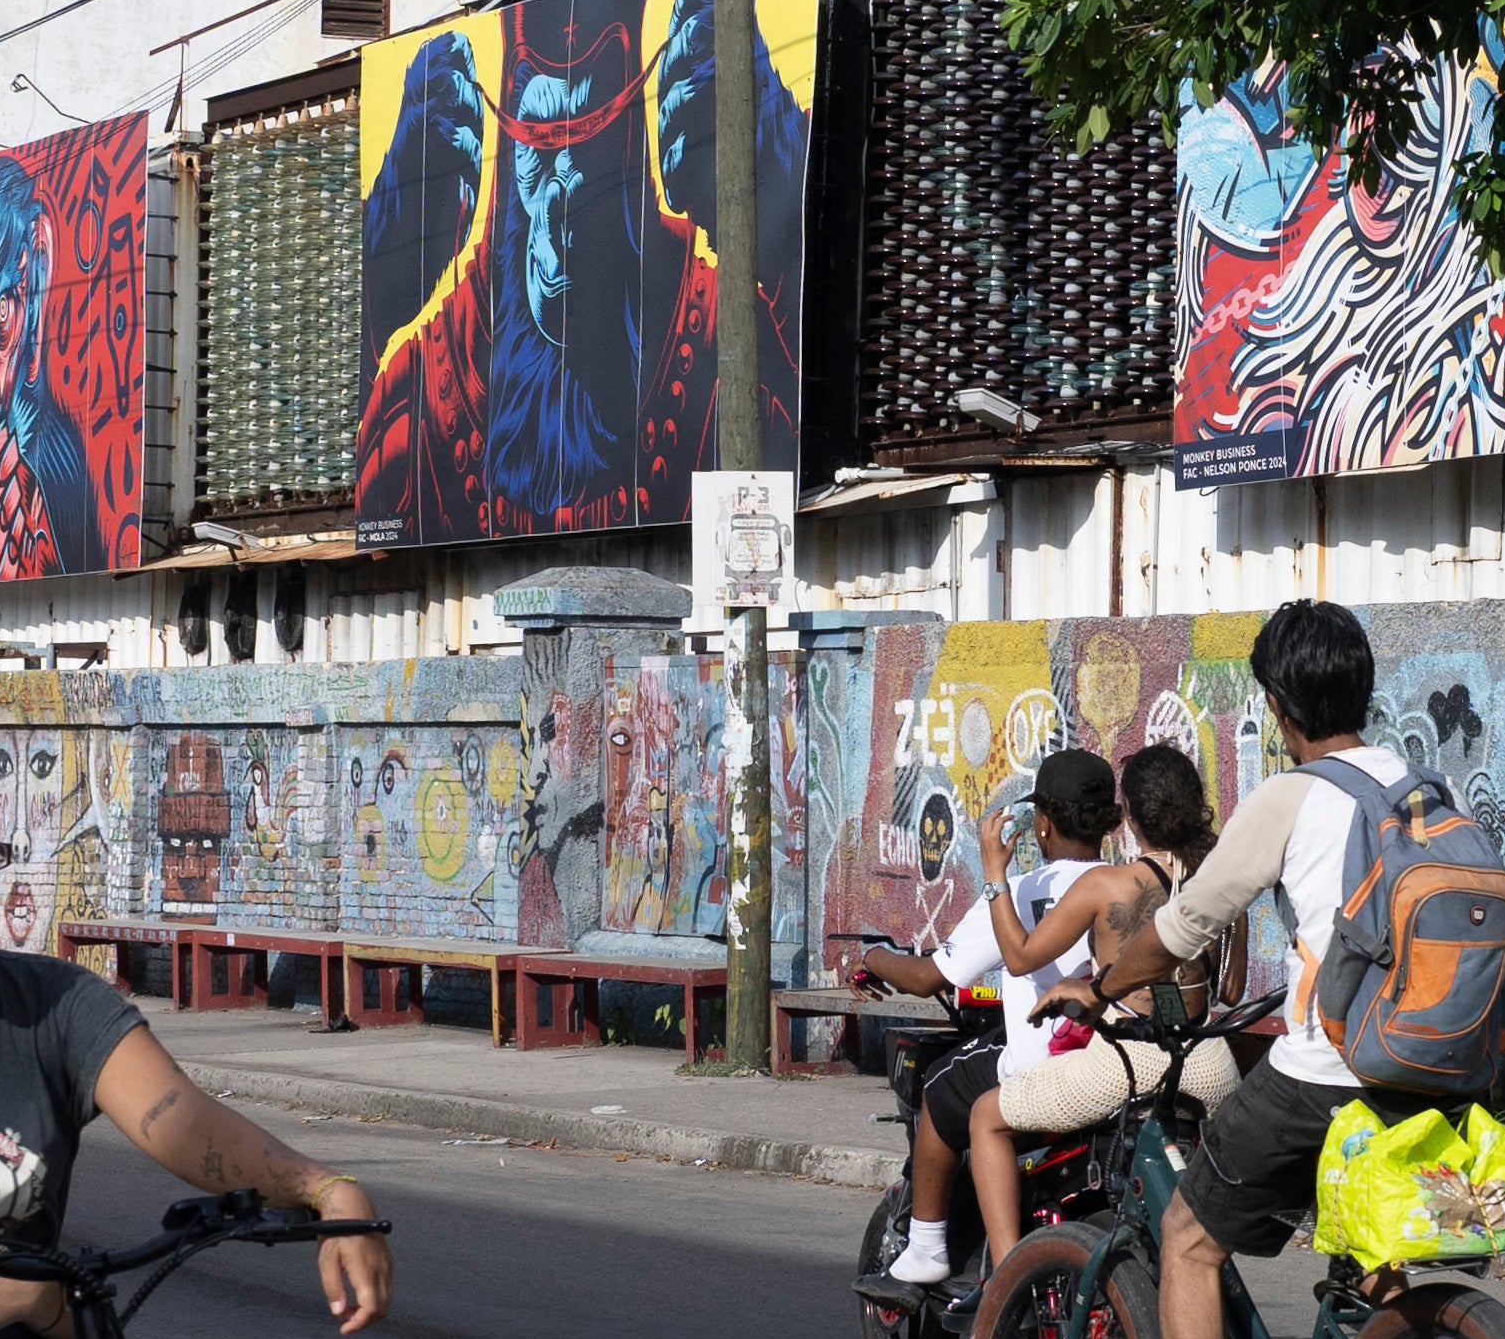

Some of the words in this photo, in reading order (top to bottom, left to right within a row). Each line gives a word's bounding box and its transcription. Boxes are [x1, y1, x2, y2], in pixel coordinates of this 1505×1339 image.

[1182, 450, 1214, 465] MONKEY
[1216, 445, 1256, 460] BUSINESS
[1183, 468, 1198, 480] FAC
[1203, 463, 1237, 477] NELSON
[1238, 459, 1268, 473] PONCE
[1268, 455, 1287, 469] 2024
[737, 486, 769, 505] P-3
